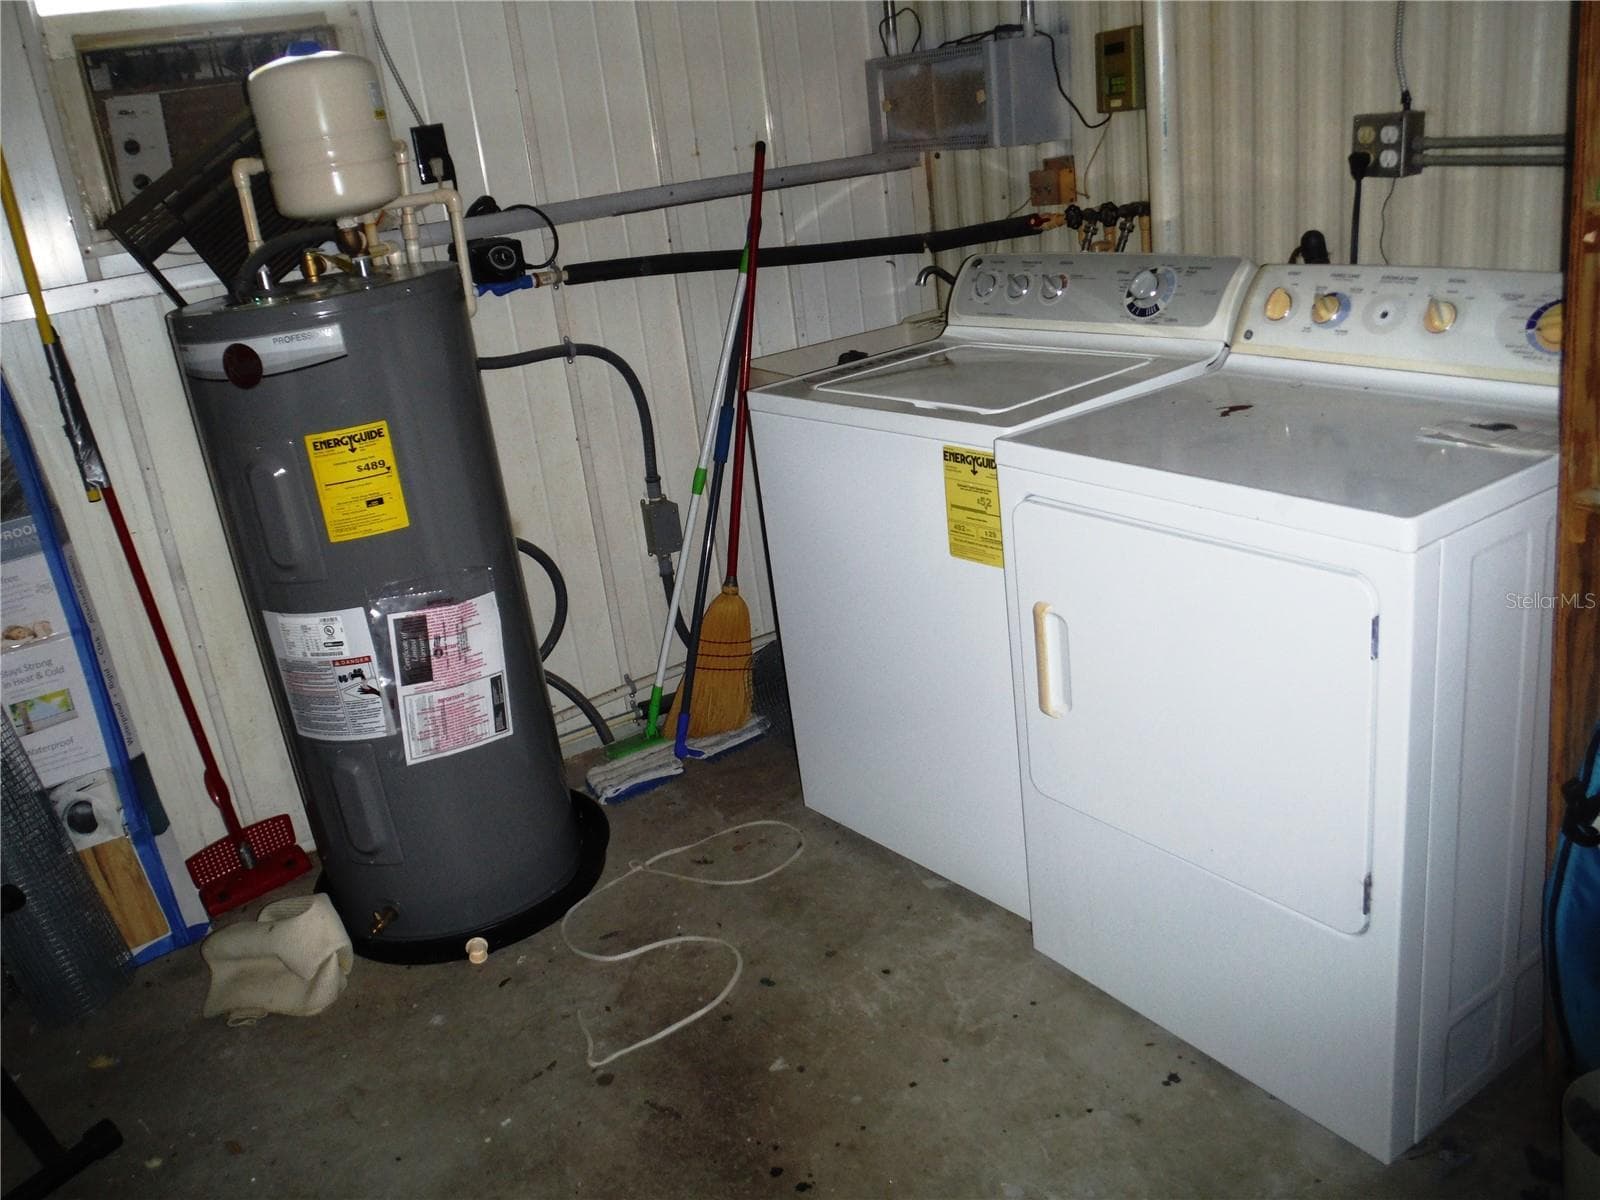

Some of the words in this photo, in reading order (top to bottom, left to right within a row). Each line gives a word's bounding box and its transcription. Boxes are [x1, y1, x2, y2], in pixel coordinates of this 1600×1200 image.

[272, 328, 337, 345] PROFESS
[312, 428, 385, 453] ENERGYGUIDE
[356, 459, 386, 473] $489
[943, 450, 997, 476] ENERGYGUID
[23, 659, 53, 672] Strong
[44, 664, 65, 677] Cold
